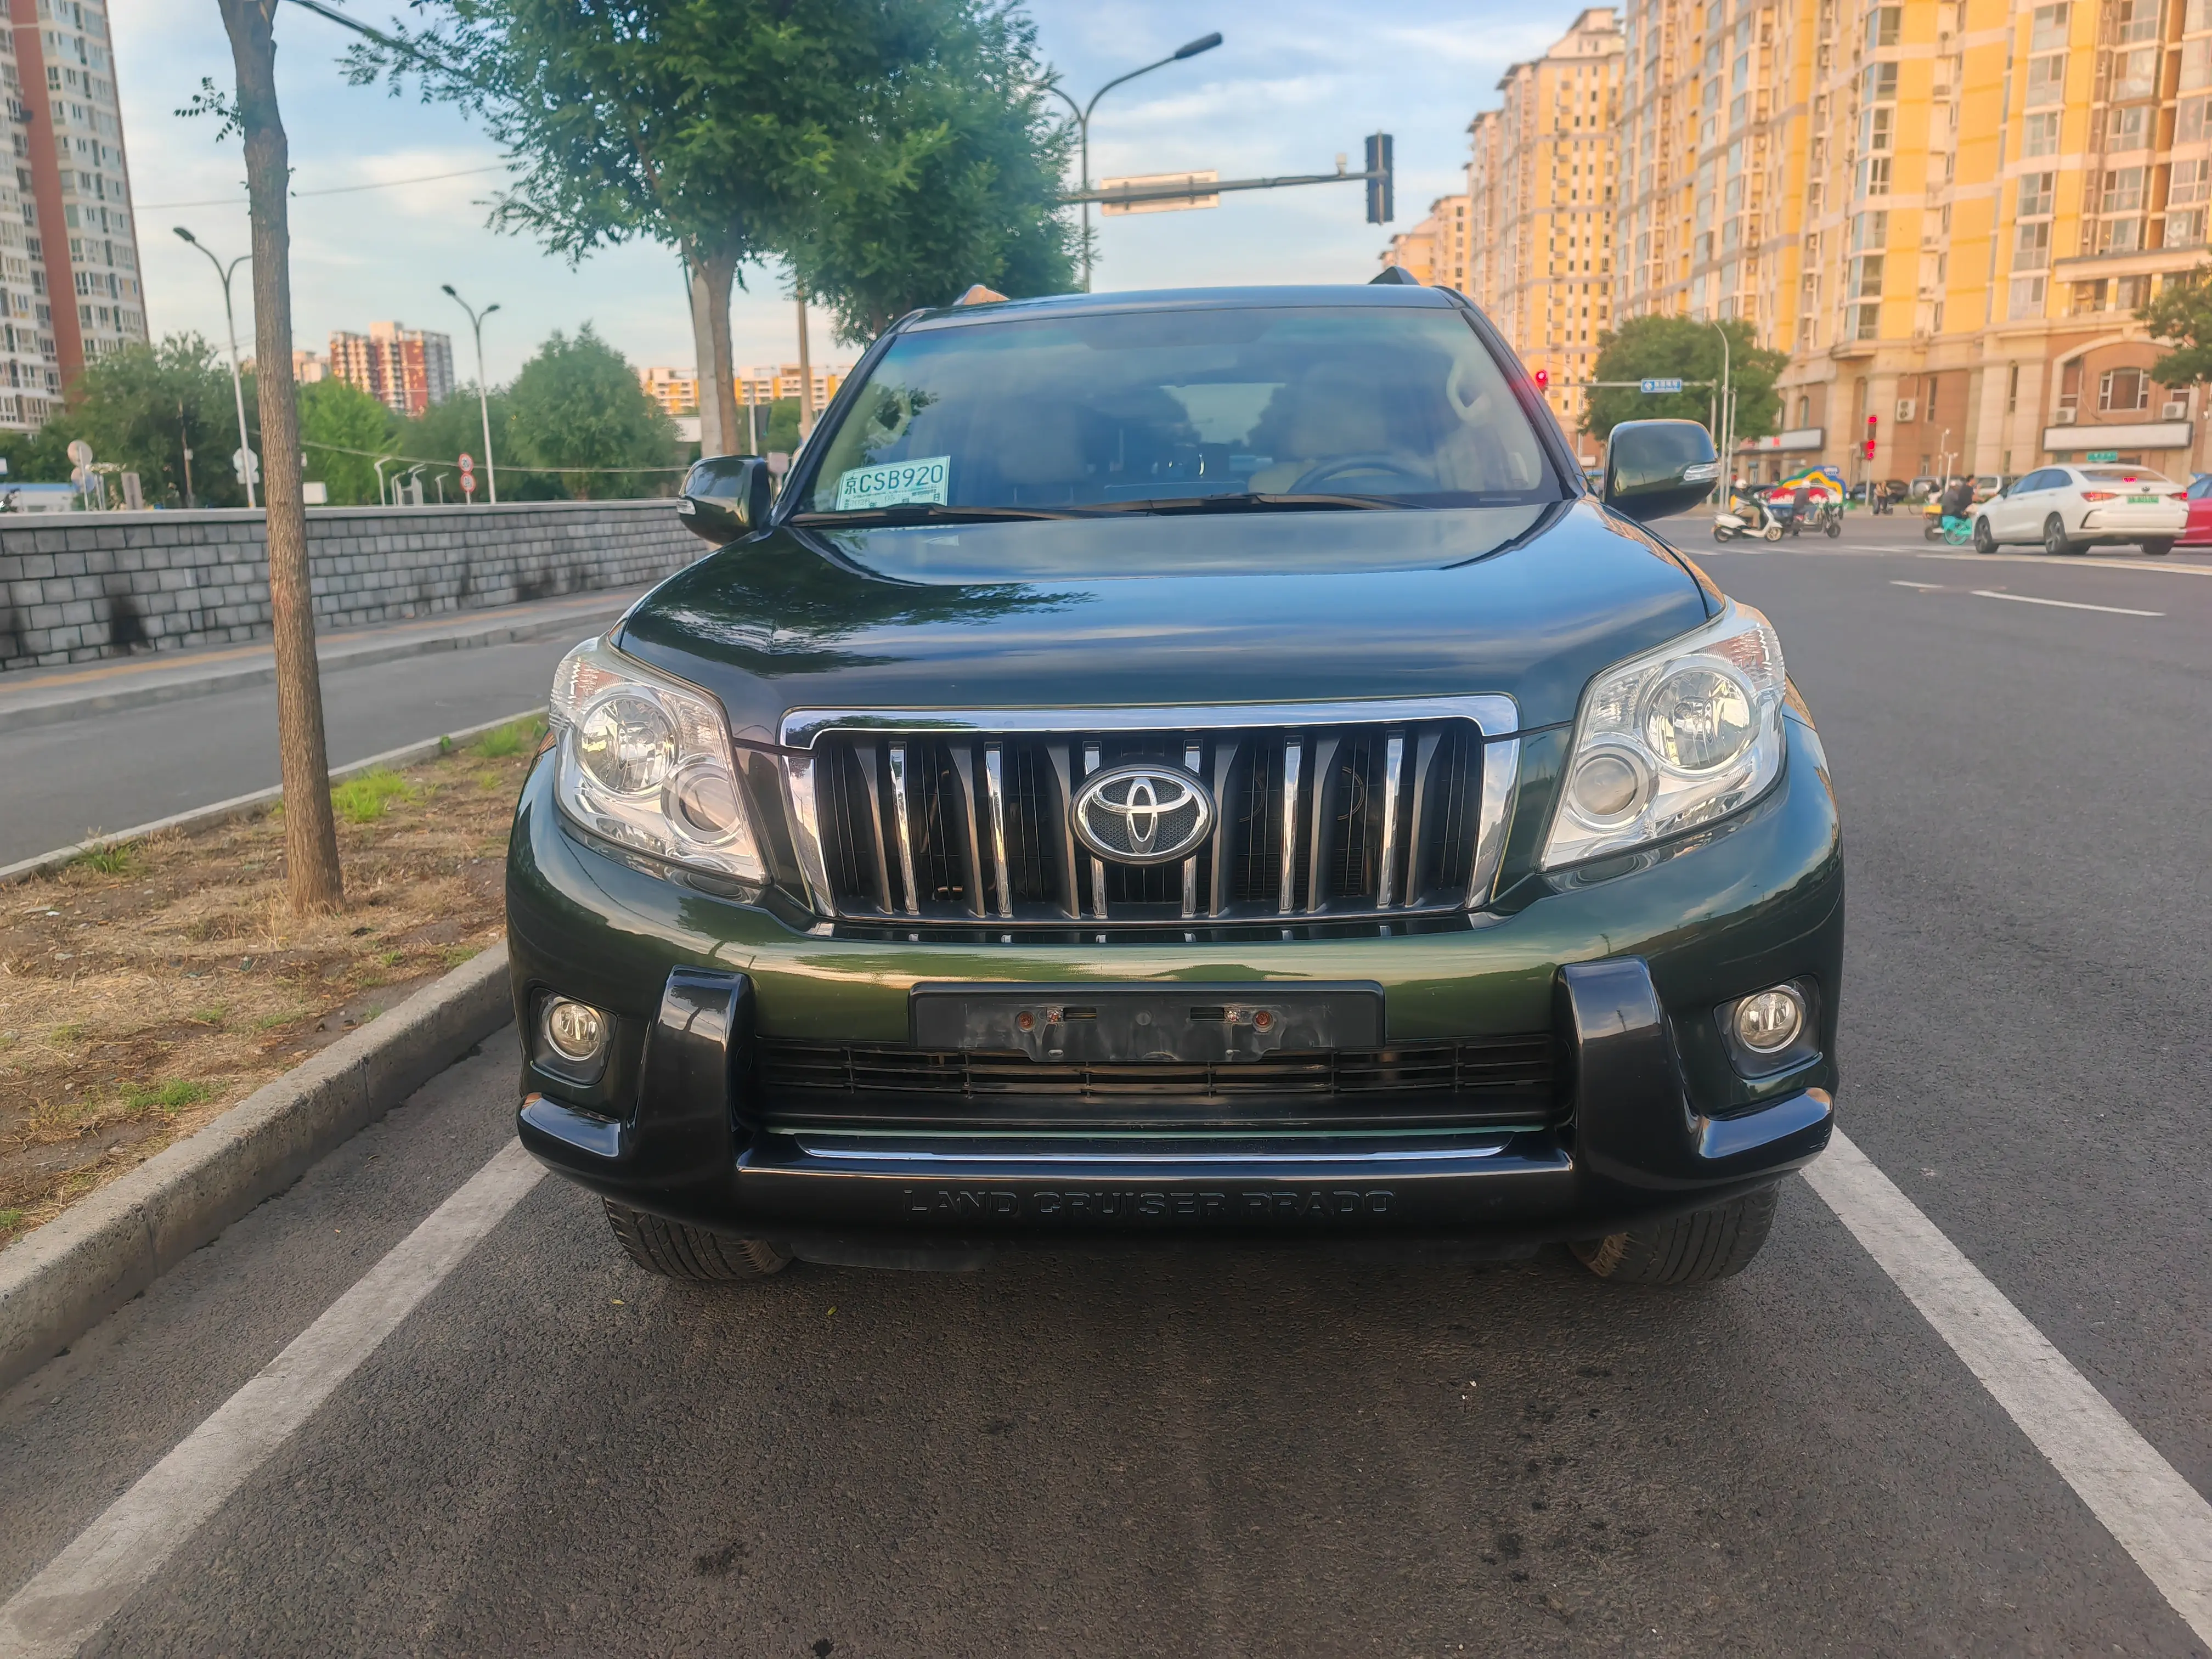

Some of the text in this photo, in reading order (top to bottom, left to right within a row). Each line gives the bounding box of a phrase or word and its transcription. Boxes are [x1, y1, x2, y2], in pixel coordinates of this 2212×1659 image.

[844, 464, 943, 495] 京CSB920
[904, 1189, 1396, 1218] LAND CRUISER PRADO
